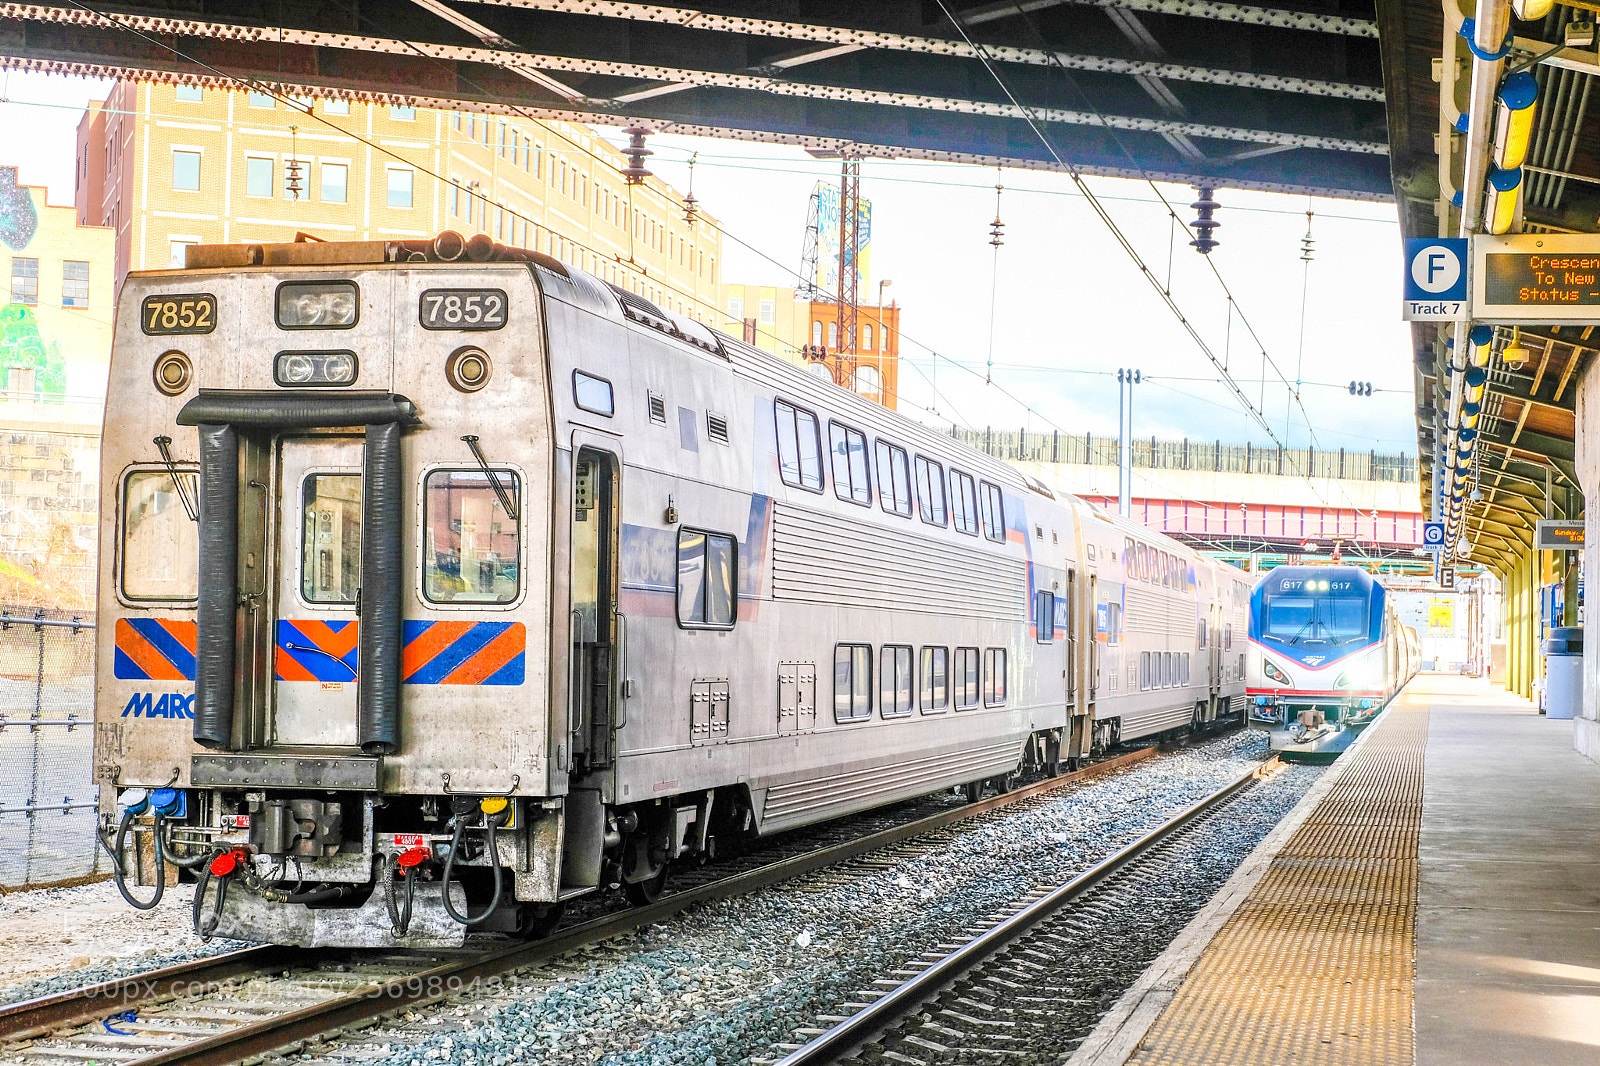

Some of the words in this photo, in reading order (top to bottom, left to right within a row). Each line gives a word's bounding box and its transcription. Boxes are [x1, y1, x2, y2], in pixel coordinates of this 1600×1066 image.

[1428, 254, 1445, 283] F
[1530, 256, 1600, 269] Crescen
[1535, 271, 1555, 285] To
[1565, 271, 1595, 285] New
[1520, 287, 1579, 301] Status
[147, 300, 211, 329] 7852
[426, 295, 502, 323] 7852
[1410, 303, 1446, 315] Track
[1452, 303, 1460, 315] 7
[1428, 528, 1438, 540] G
[1283, 581, 1303, 589] 617
[1442, 569, 1453, 587] E
[1331, 582, 1351, 590] 617
